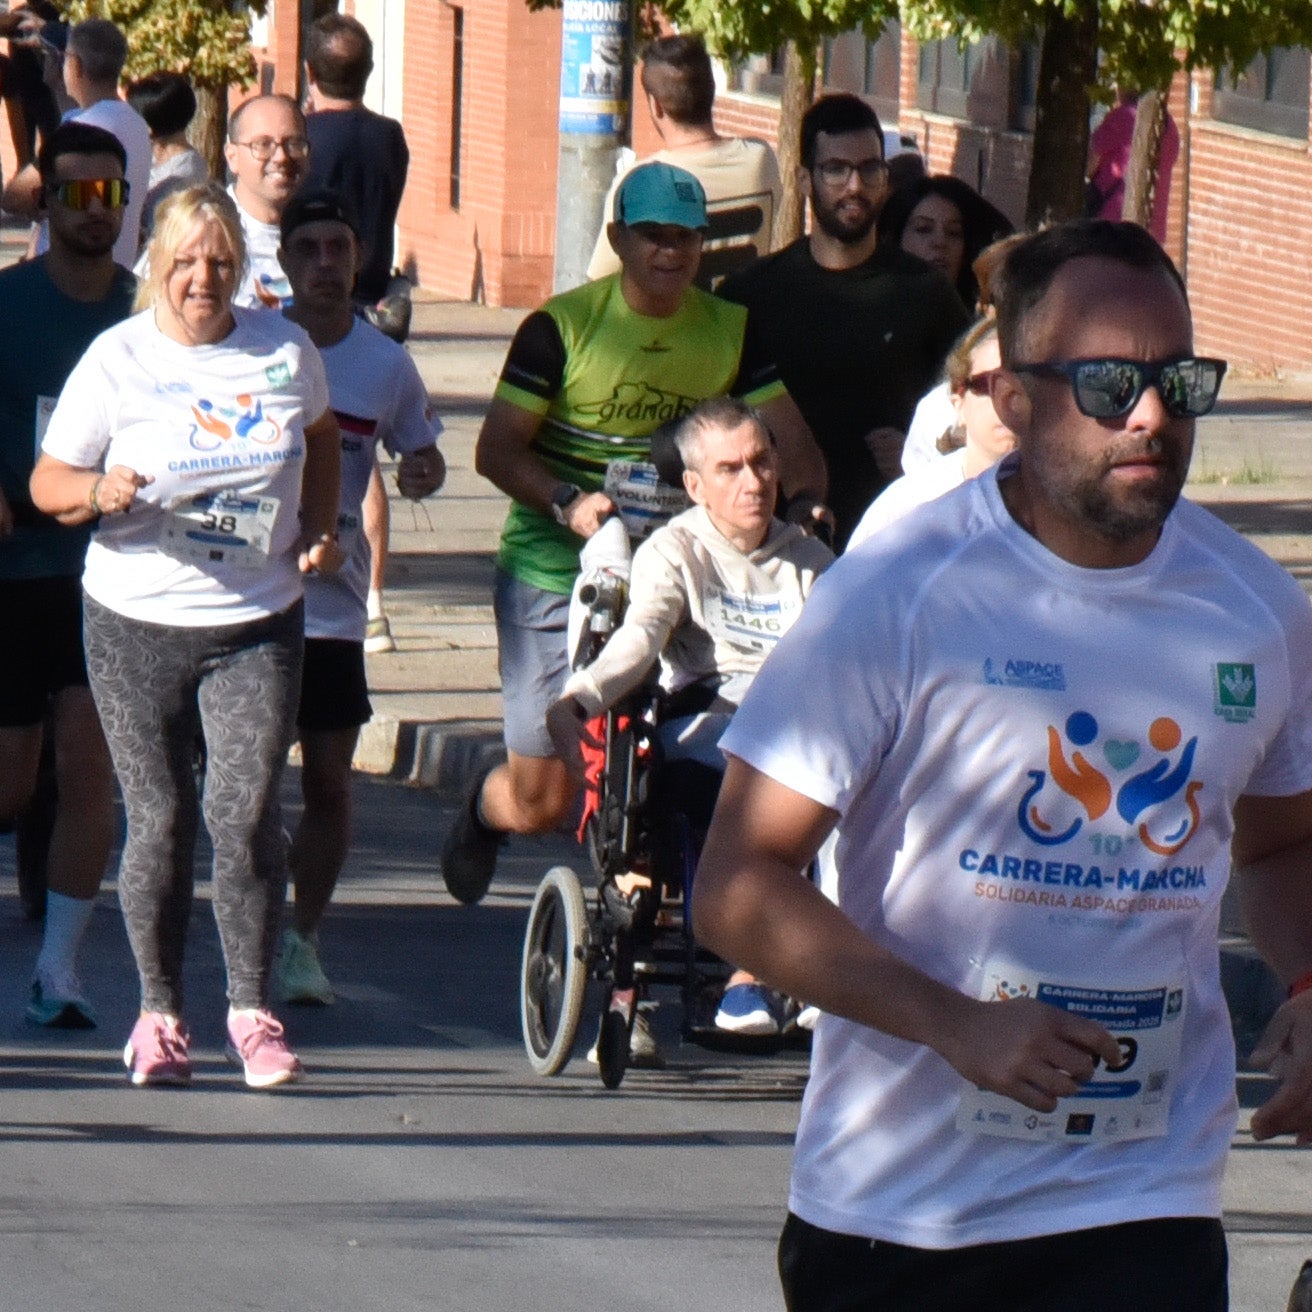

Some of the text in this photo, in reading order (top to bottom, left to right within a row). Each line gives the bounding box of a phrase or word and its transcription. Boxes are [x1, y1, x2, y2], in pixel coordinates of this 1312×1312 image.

[720, 607, 782, 632] 1446
[958, 848, 1206, 892] CARRERA-MARCHA
[974, 881, 1066, 908] SOLIDARIA
